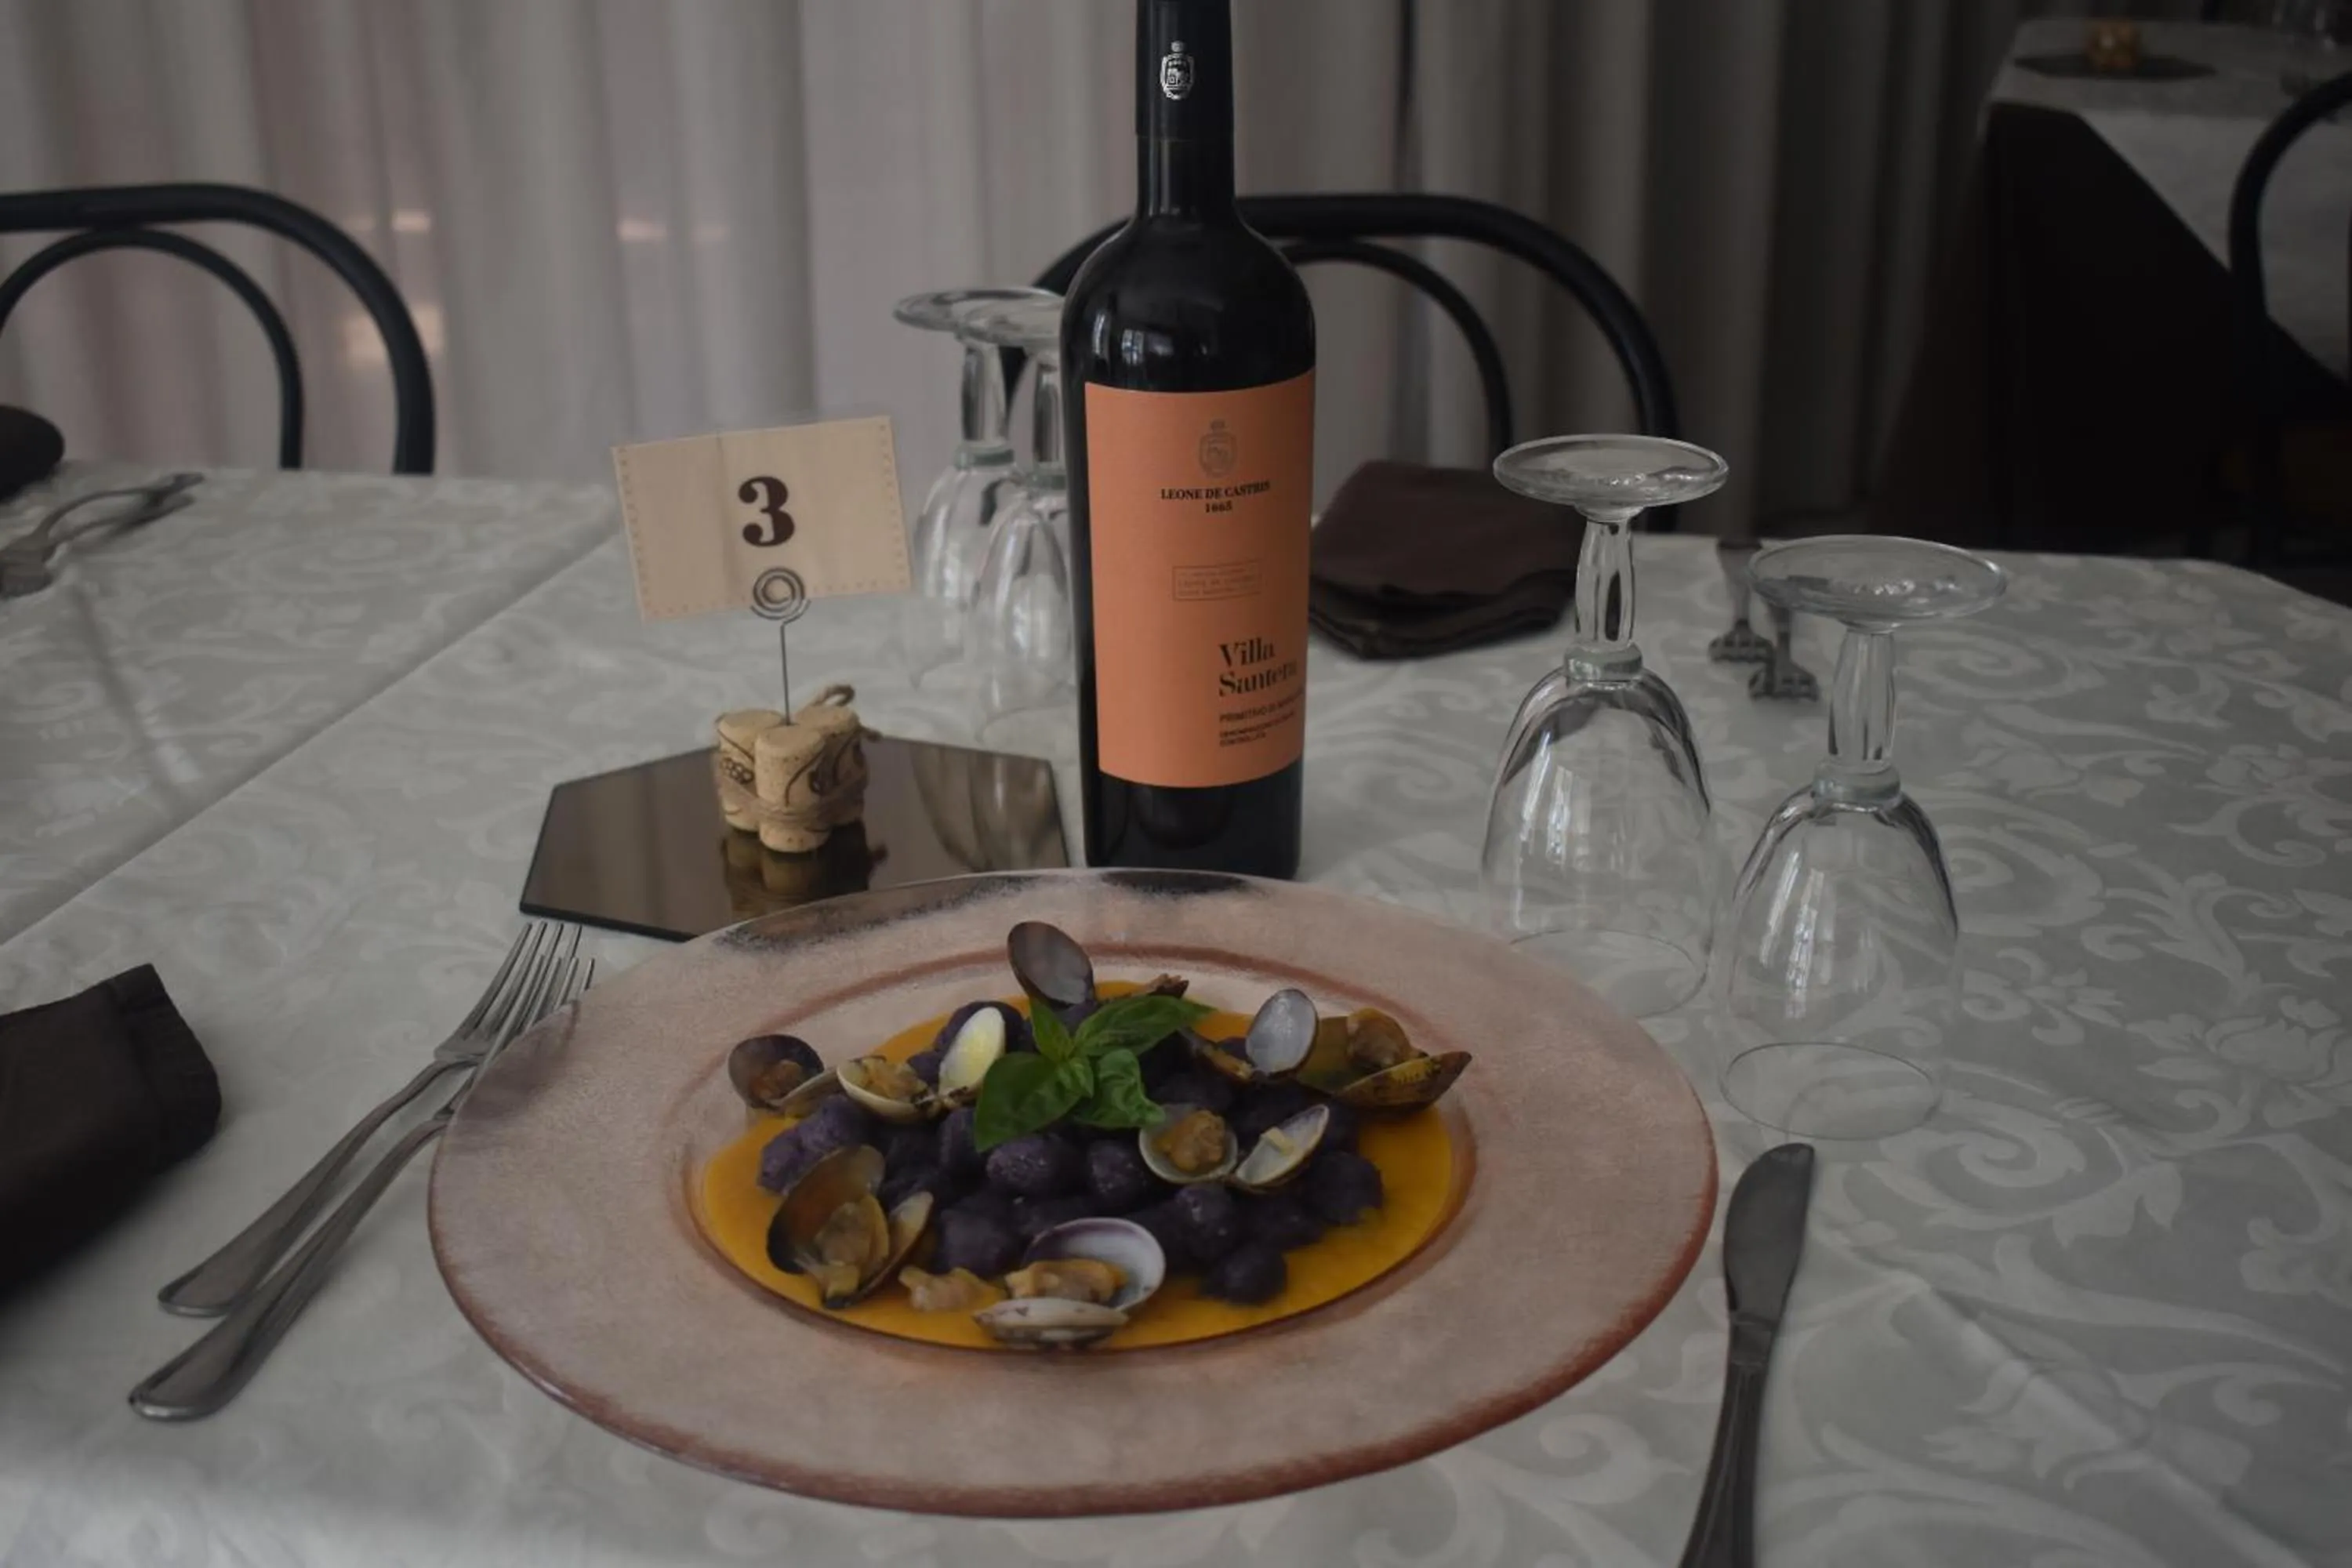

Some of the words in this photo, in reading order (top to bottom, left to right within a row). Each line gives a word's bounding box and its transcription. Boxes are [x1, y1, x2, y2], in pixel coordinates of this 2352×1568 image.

[1160, 488, 1203, 500] LEONE
[1205, 488, 1221, 499] DE
[738, 475, 795, 547] 3
[1218, 637, 1276, 667] Villa
